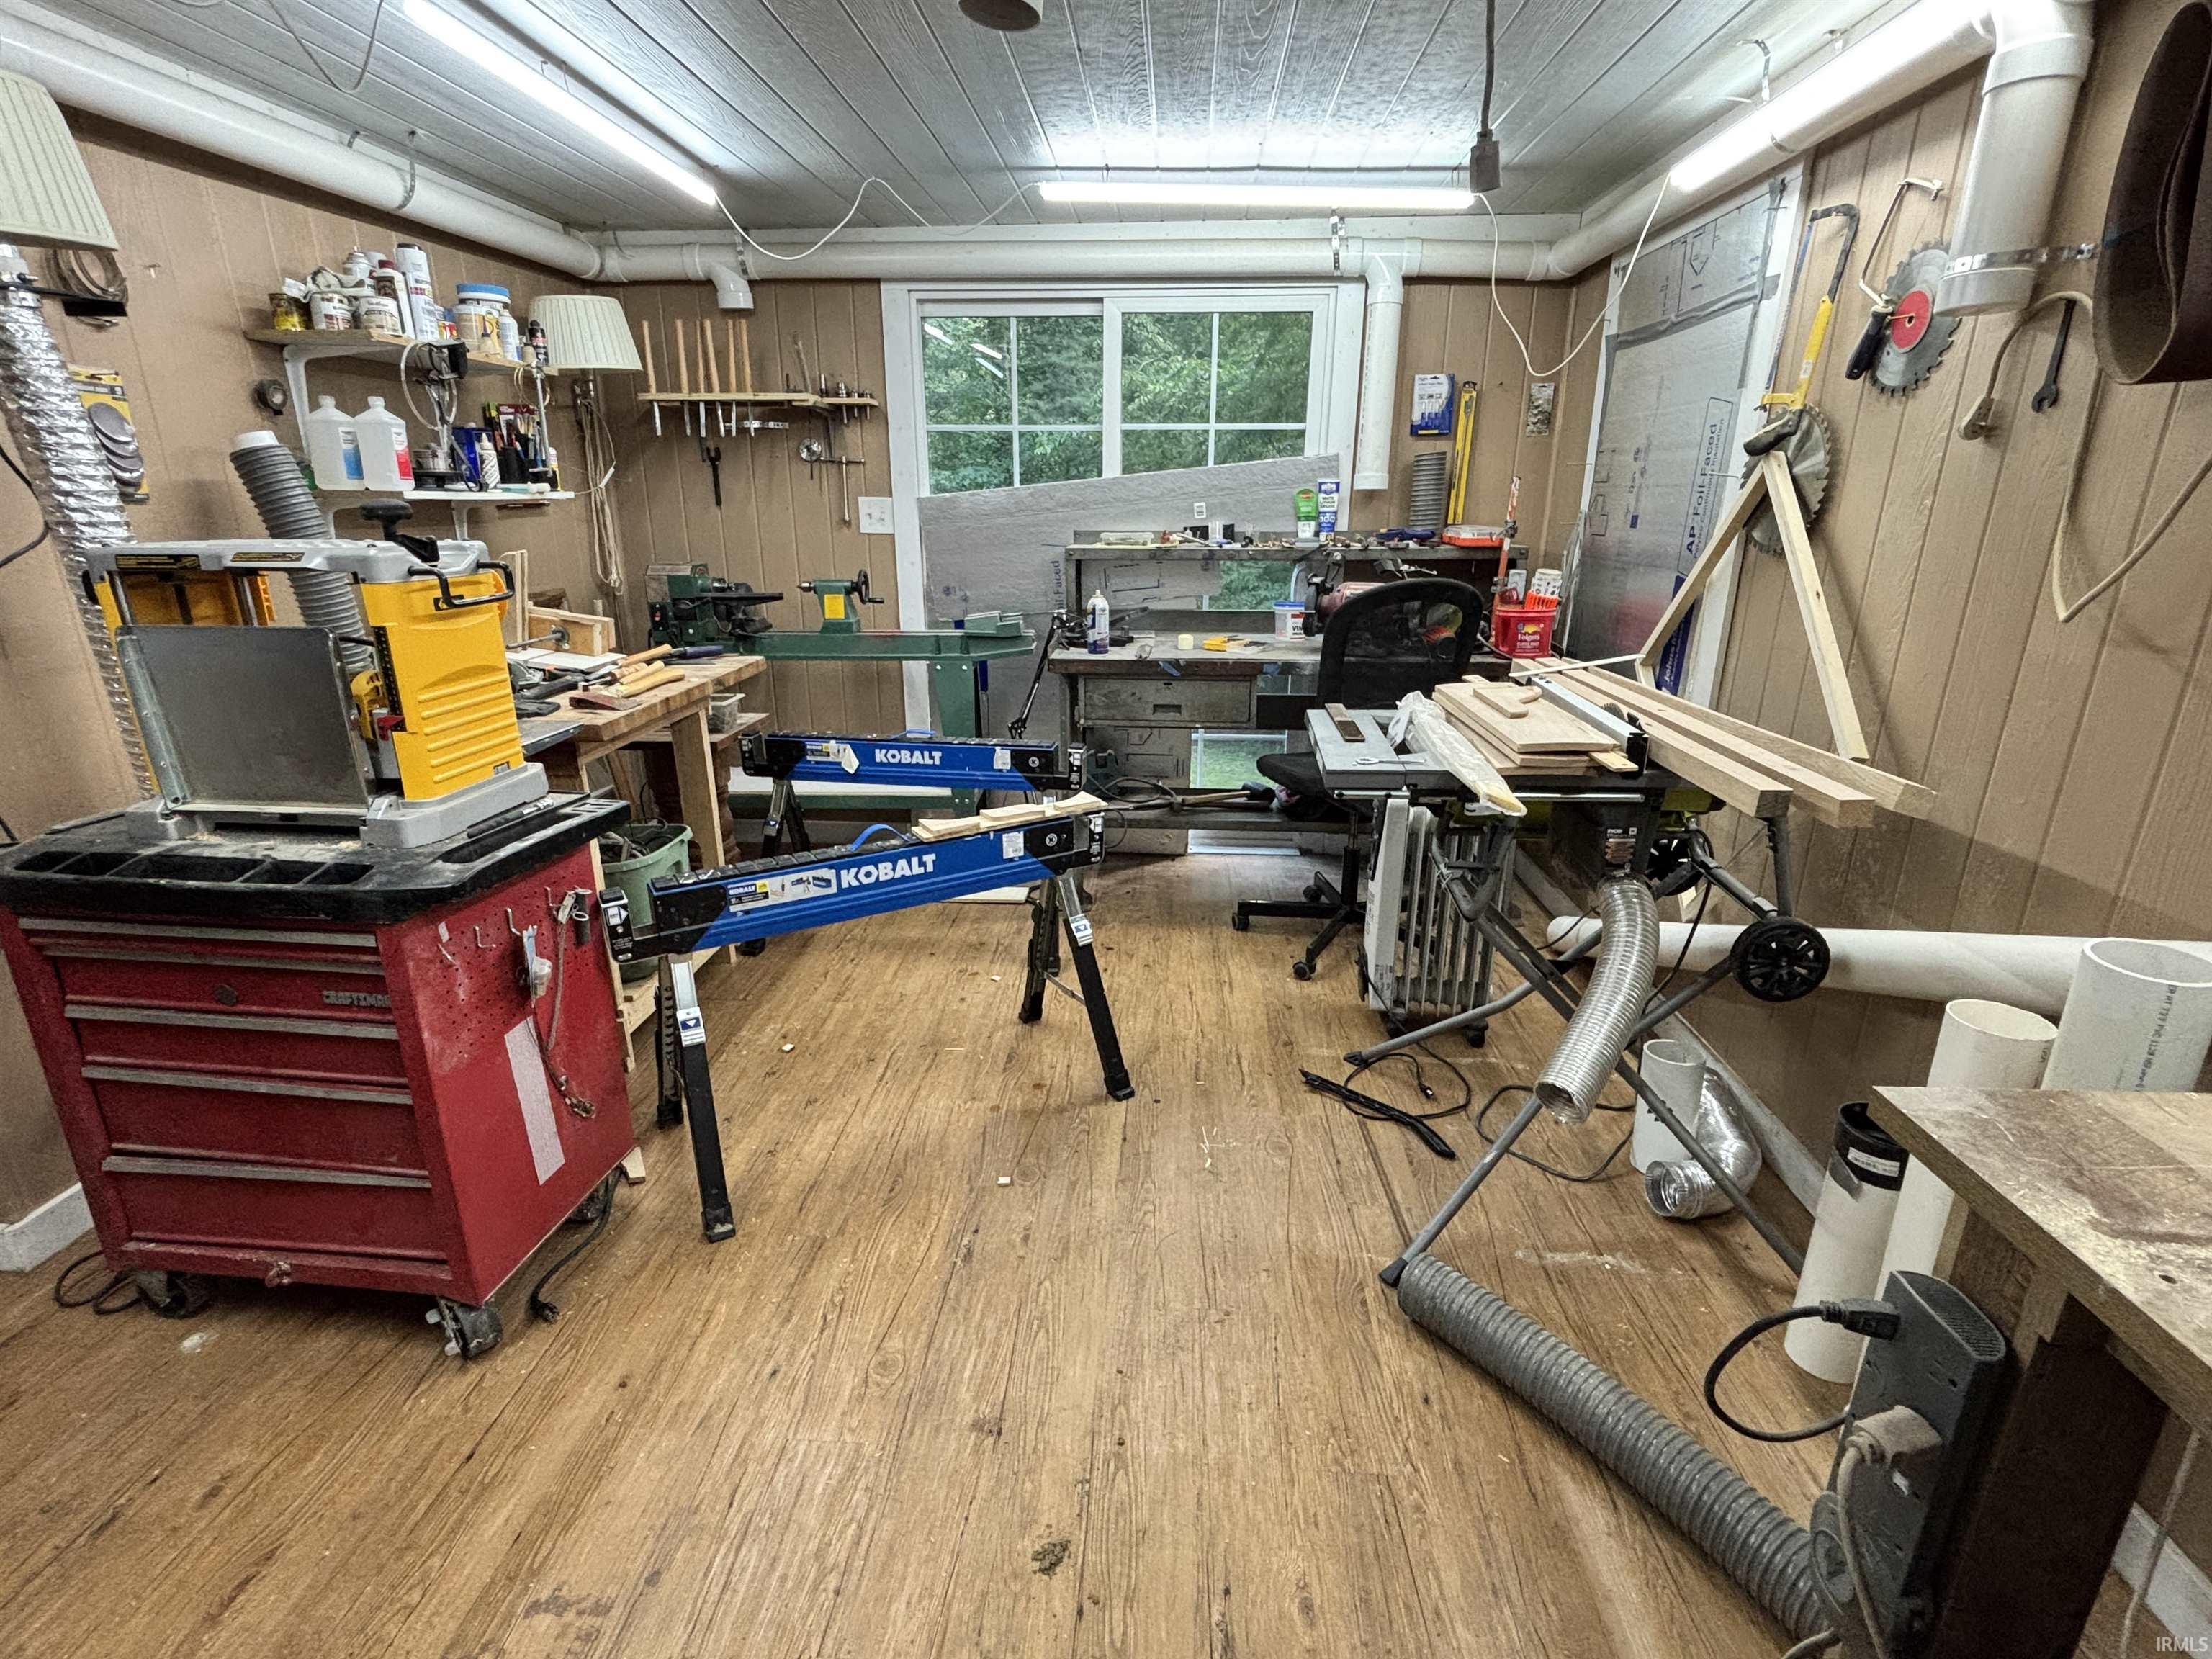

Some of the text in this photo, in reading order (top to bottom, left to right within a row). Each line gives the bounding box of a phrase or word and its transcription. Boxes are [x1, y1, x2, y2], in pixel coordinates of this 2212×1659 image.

[1686, 423, 1717, 554] AP Foil-Faced
[1517, 633, 1541, 642] Folgers
[874, 748, 943, 765] KOBALT
[840, 853, 936, 889] KOBALT
